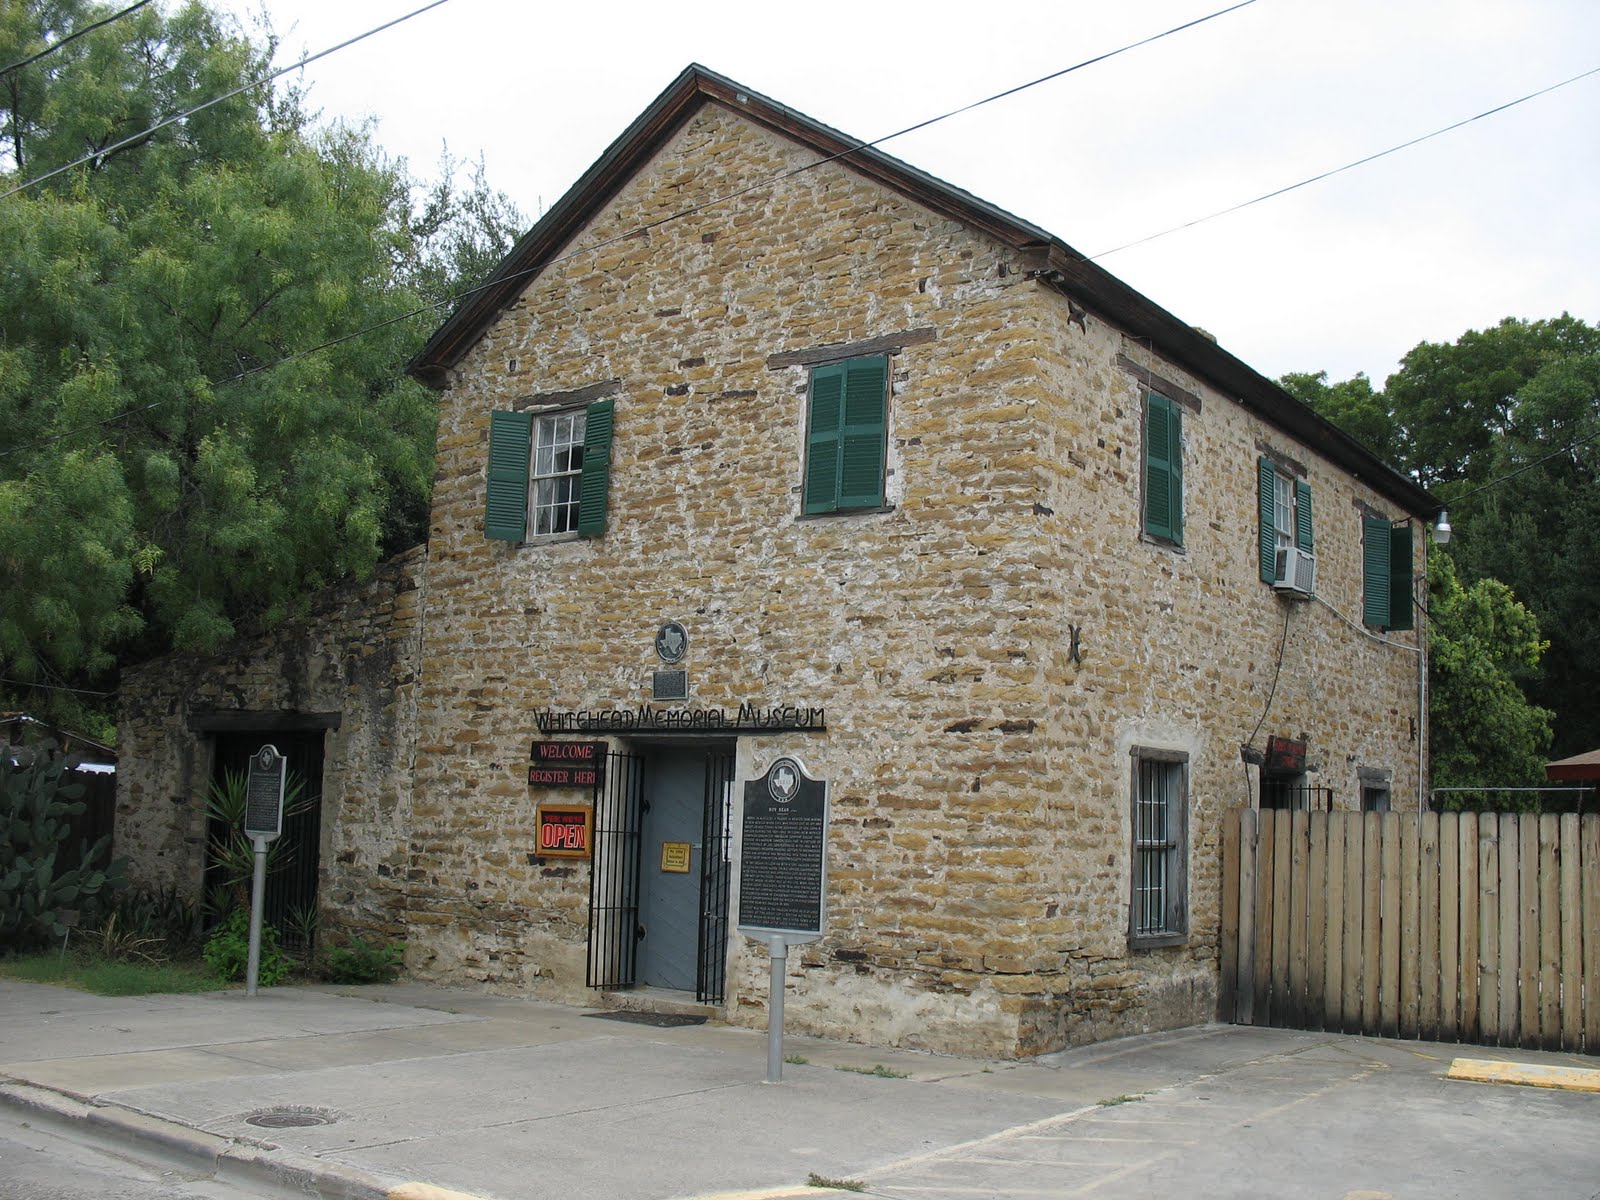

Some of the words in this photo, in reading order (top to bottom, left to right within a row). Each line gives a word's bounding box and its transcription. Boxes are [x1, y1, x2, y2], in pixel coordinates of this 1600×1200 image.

[533, 708, 634, 730] WHITEHEAD
[636, 705, 734, 730] MEMORIAL
[736, 703, 824, 729] MUSEUM
[540, 745, 594, 759] WELCOME
[530, 770, 569, 783] REGISTER
[542, 823, 586, 849] OPEN
